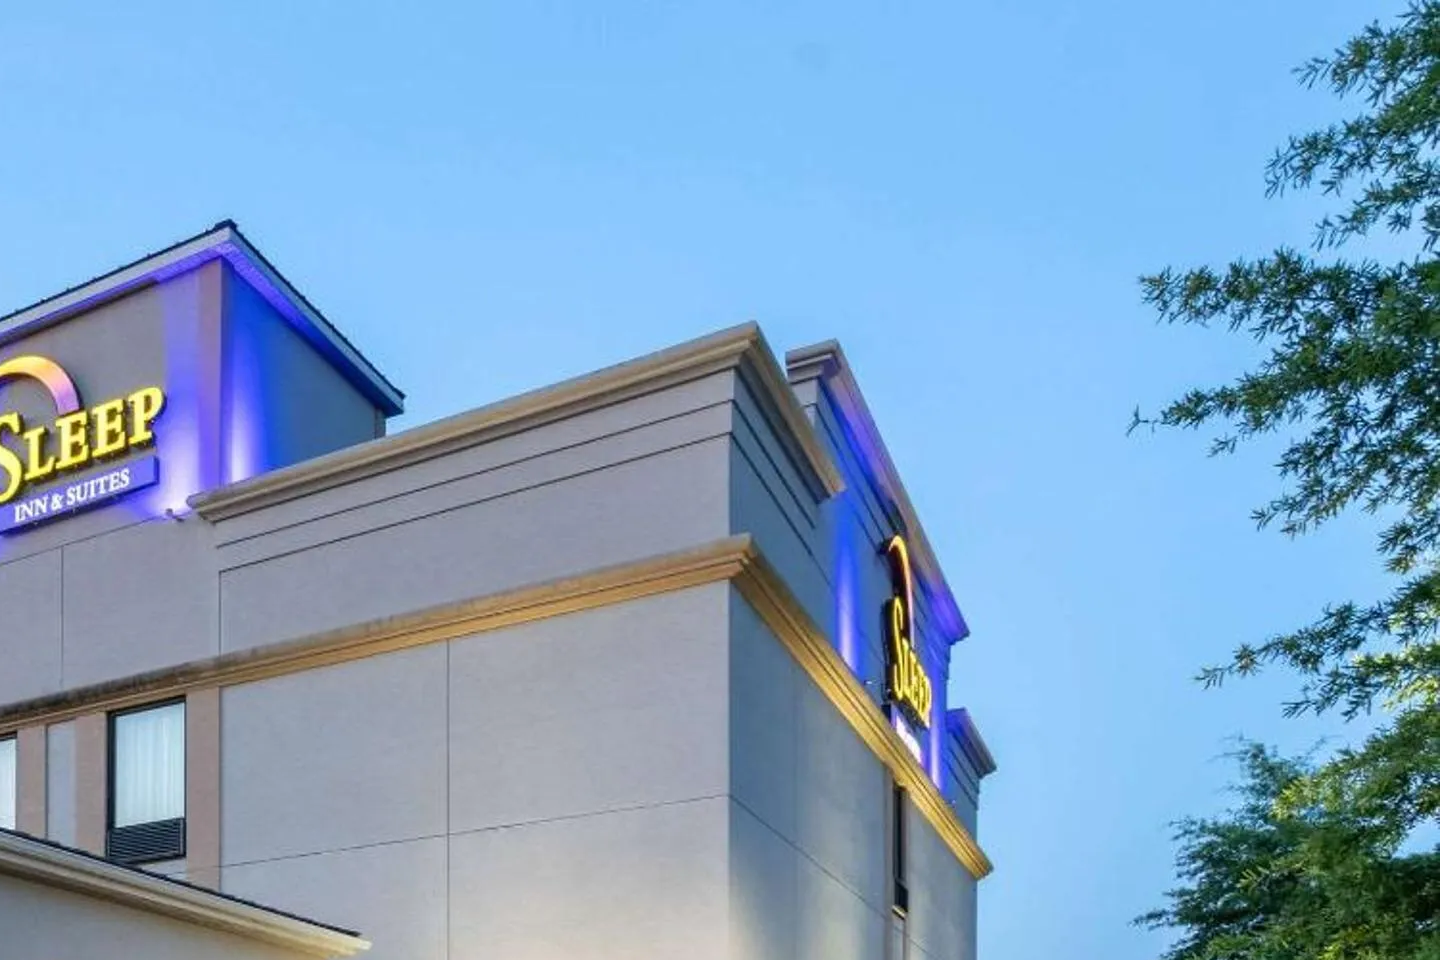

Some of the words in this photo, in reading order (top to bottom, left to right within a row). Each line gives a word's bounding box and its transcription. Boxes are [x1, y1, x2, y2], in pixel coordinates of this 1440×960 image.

[14, 494, 49, 523] INN
[51, 493, 64, 511] &
[66, 467, 131, 506] SUITES
